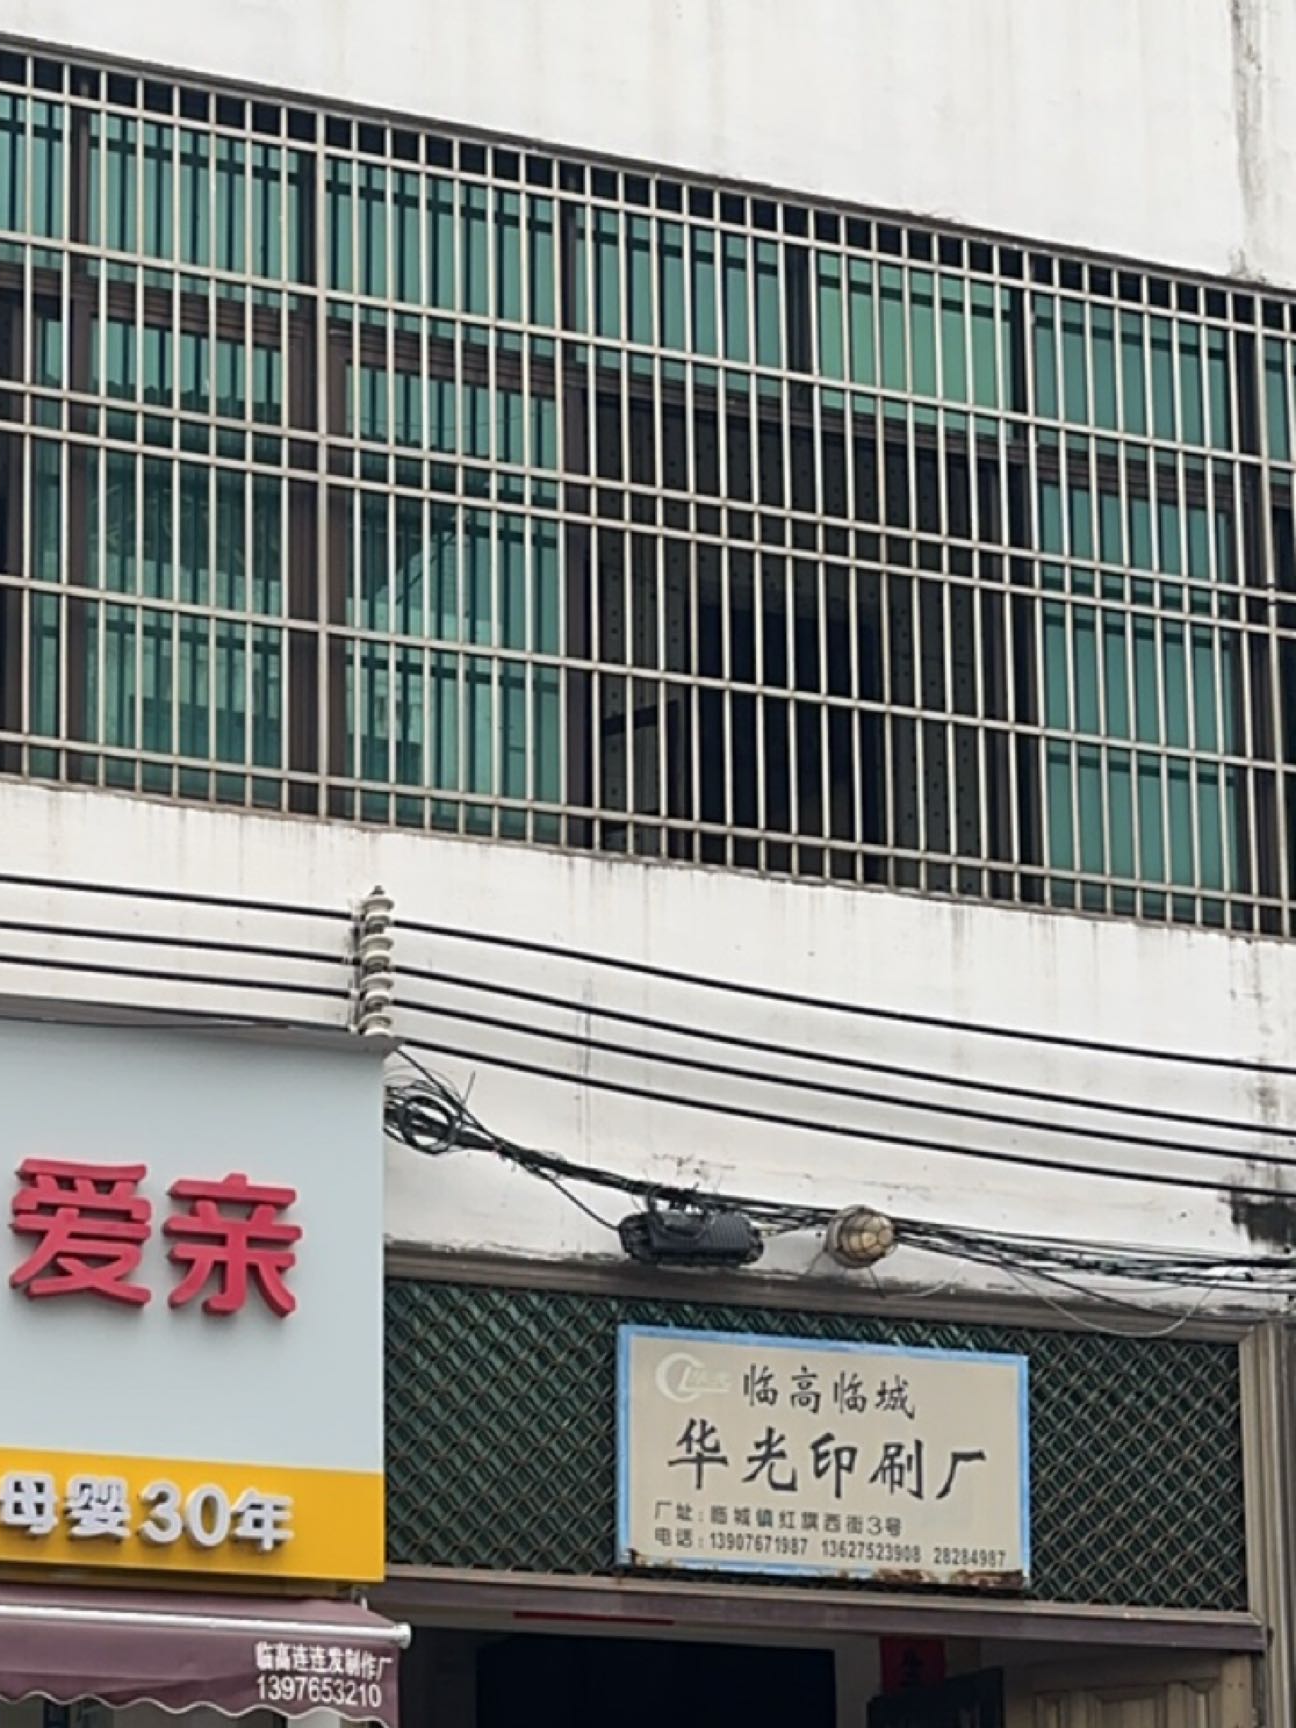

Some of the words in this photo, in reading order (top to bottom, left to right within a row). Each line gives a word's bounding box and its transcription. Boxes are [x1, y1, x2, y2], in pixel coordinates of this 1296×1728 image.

[10, 1157, 302, 1317] 爱亲
[742, 1363, 916, 1419] 临高临城
[668, 1418, 986, 1500] 华光印刷厂
